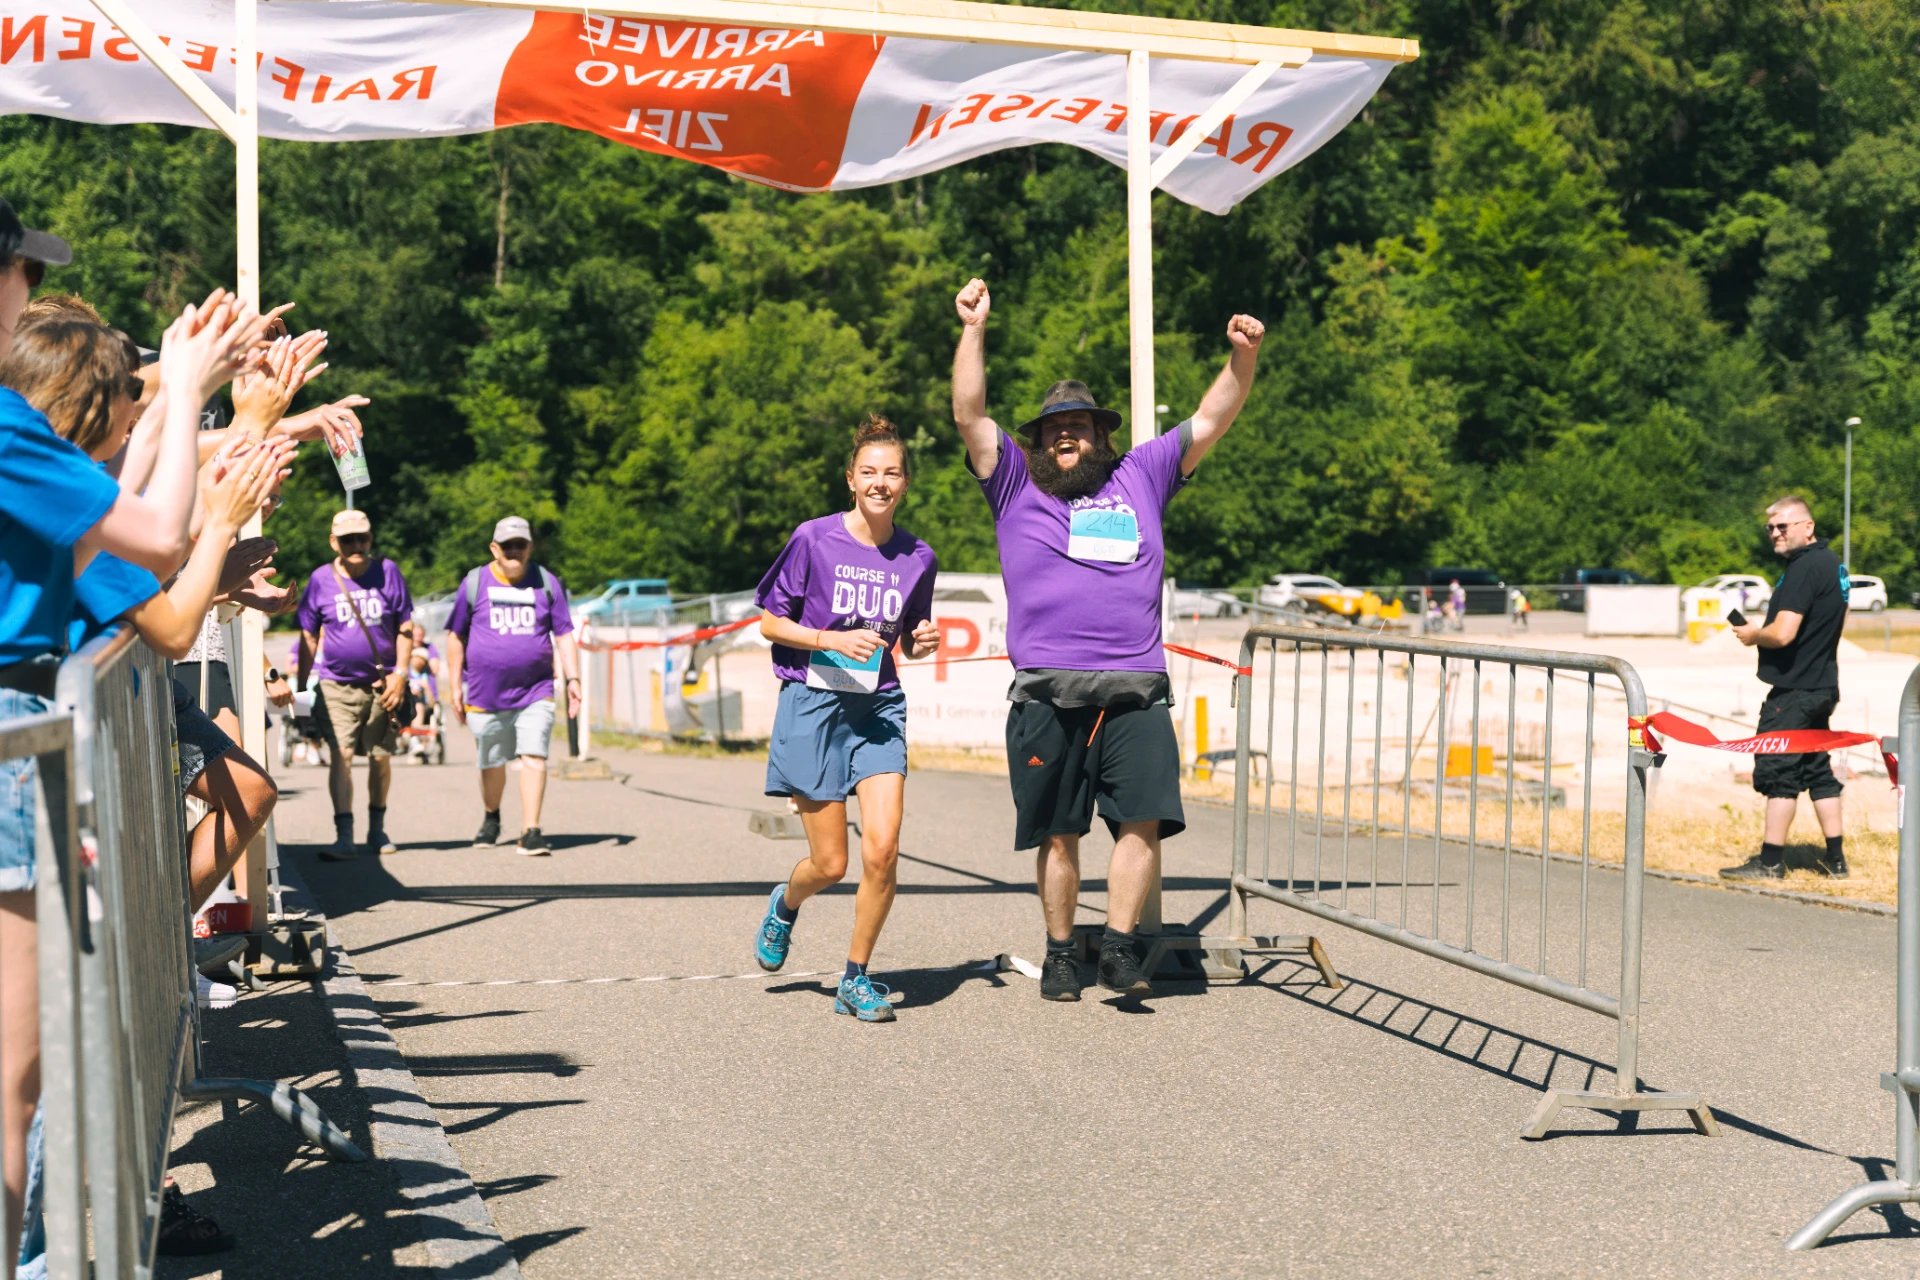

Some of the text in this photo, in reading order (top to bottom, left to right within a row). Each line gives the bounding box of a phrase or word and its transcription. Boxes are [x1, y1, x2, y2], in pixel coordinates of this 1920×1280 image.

[1086, 511, 1126, 533] 214
[835, 564, 885, 584] COURSE
[831, 580, 902, 622] DUO
[489, 606, 536, 629] DUO
[862, 620, 896, 633] SUISSE
